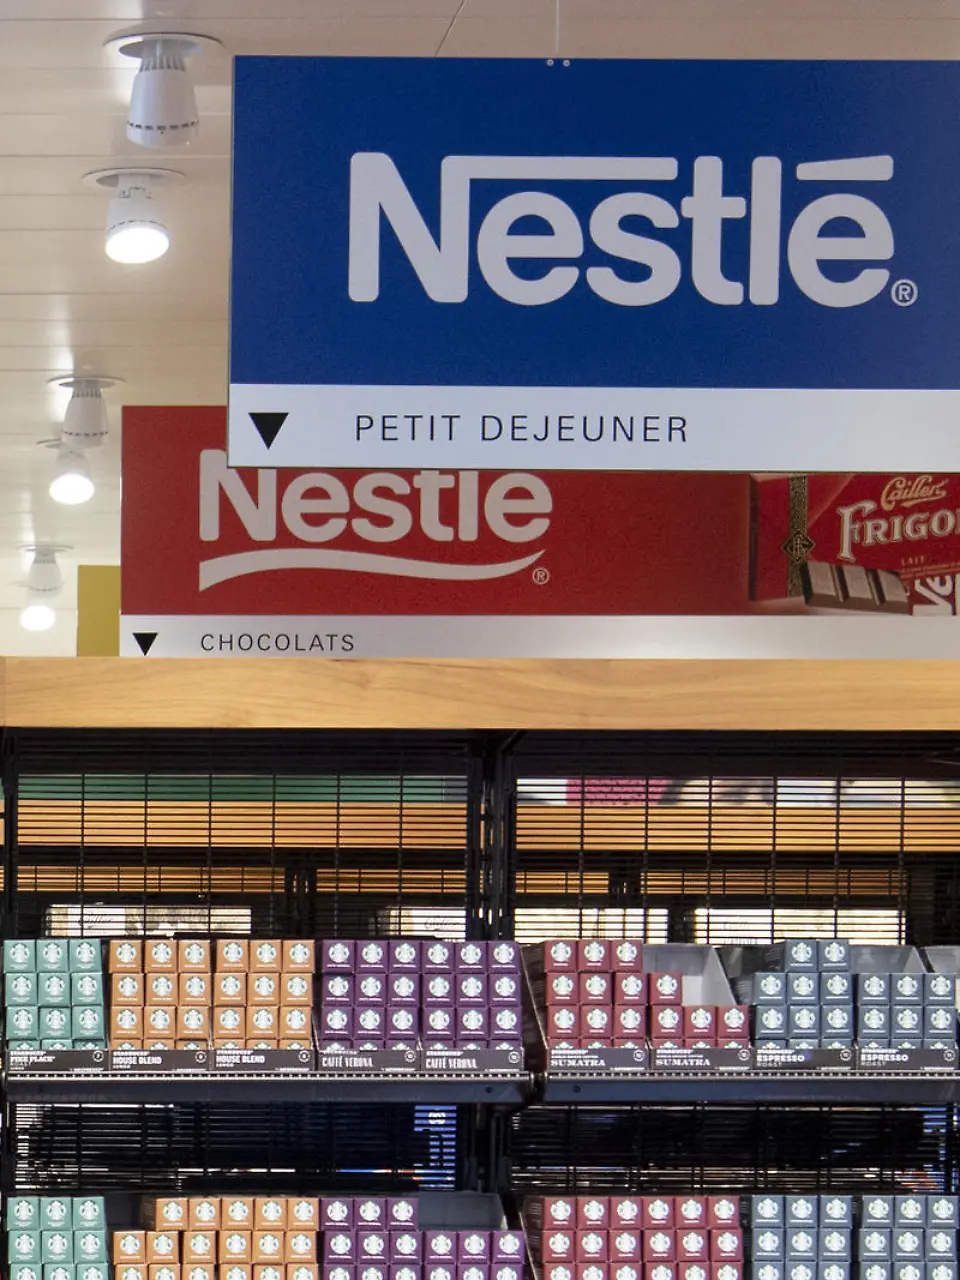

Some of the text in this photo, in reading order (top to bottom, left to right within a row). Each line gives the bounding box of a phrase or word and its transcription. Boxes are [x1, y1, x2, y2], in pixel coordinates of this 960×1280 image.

[348, 151, 896, 308] Nestlé
[355, 414, 689, 444] PETIT DEJEUNER
[880, 474, 949, 512] Cailler
[836, 499, 960, 564] FRIGO
[901, 555, 925, 566] LAIT
[200, 633, 355, 652] CHOCOLATS
[551, 1059, 606, 1067] SUMATRA
[655, 1058, 711, 1066] SUMATRA
[756, 1055, 805, 1063] ESPRESSO
[861, 1054, 909, 1062] ESPRESSO
